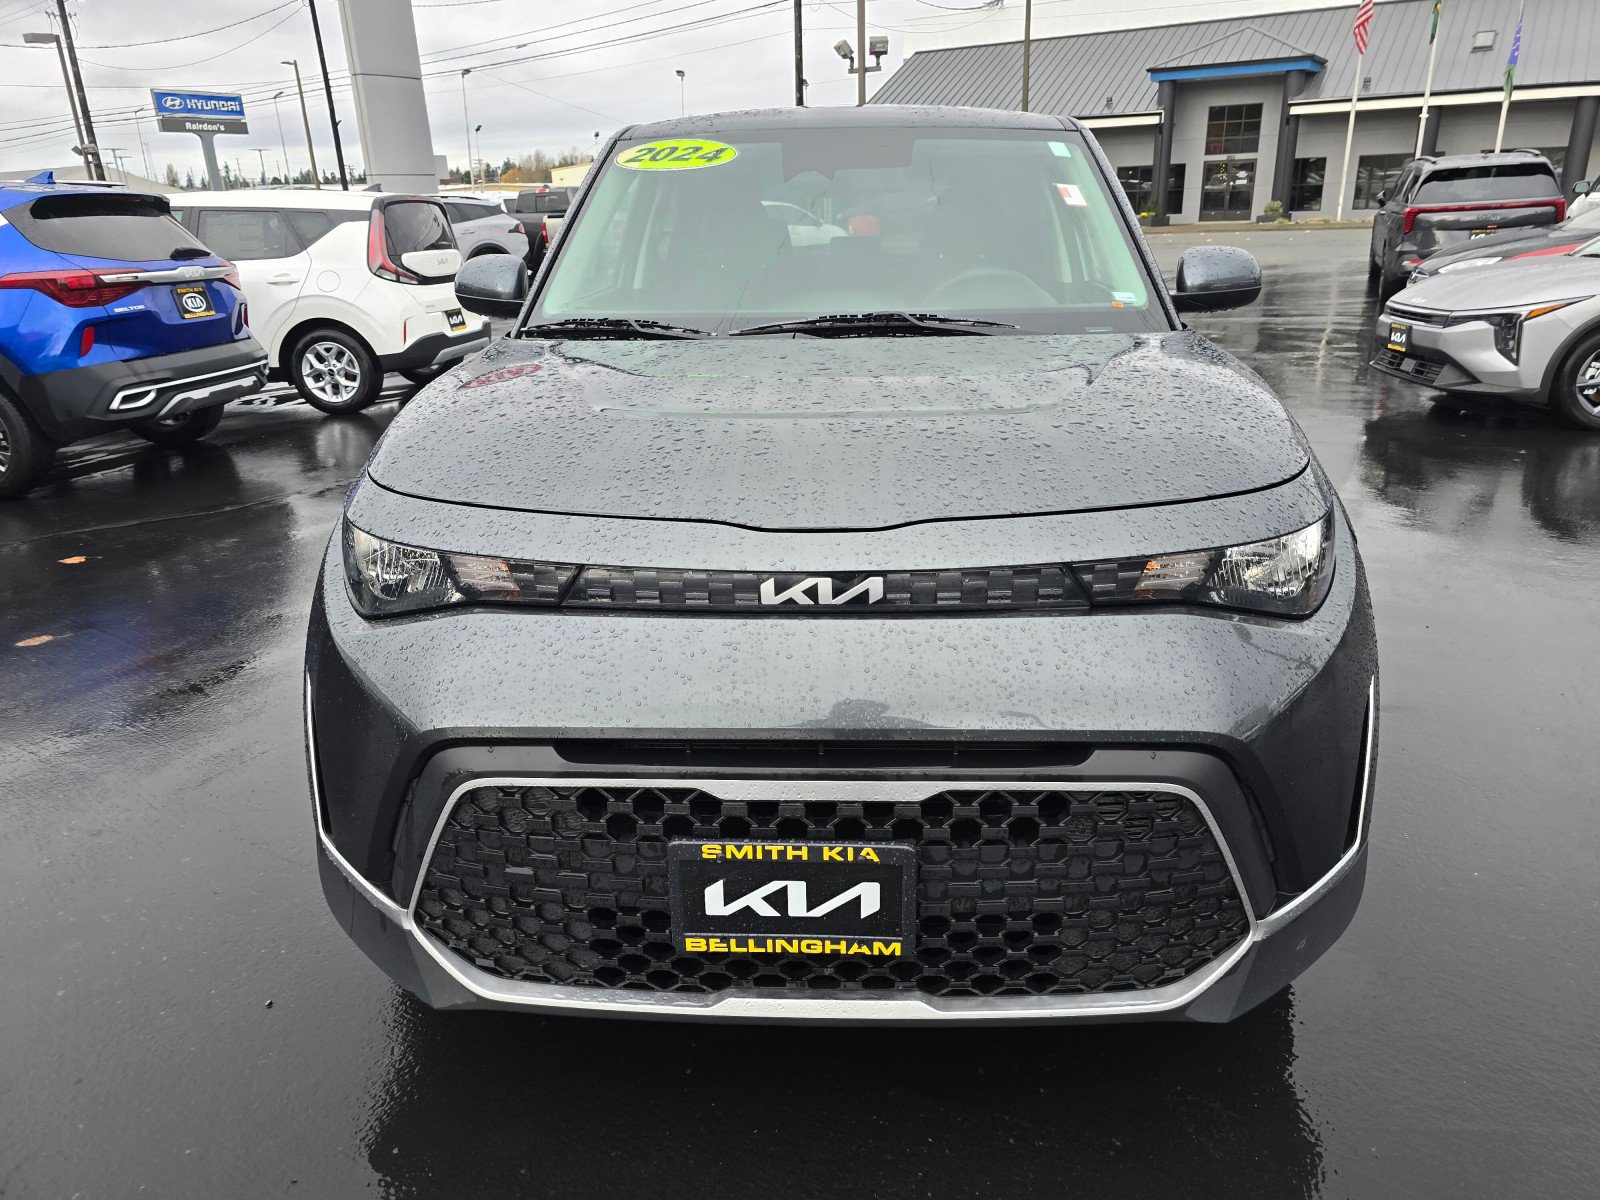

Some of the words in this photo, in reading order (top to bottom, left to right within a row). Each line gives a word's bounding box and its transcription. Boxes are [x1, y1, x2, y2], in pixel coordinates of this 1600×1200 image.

[186, 98, 240, 112] HYUNDAI
[185, 121, 225, 131] Rairdon's
[623, 146, 729, 163] 2024
[185, 297, 205, 309] KIA
[1390, 331, 1407, 344] KIA
[760, 576, 884, 605] KIA
[701, 844, 808, 860] SMITH
[822, 846, 881, 863] KIA
[704, 879, 881, 919] KIA
[685, 937, 902, 956] BELLINGHAM
